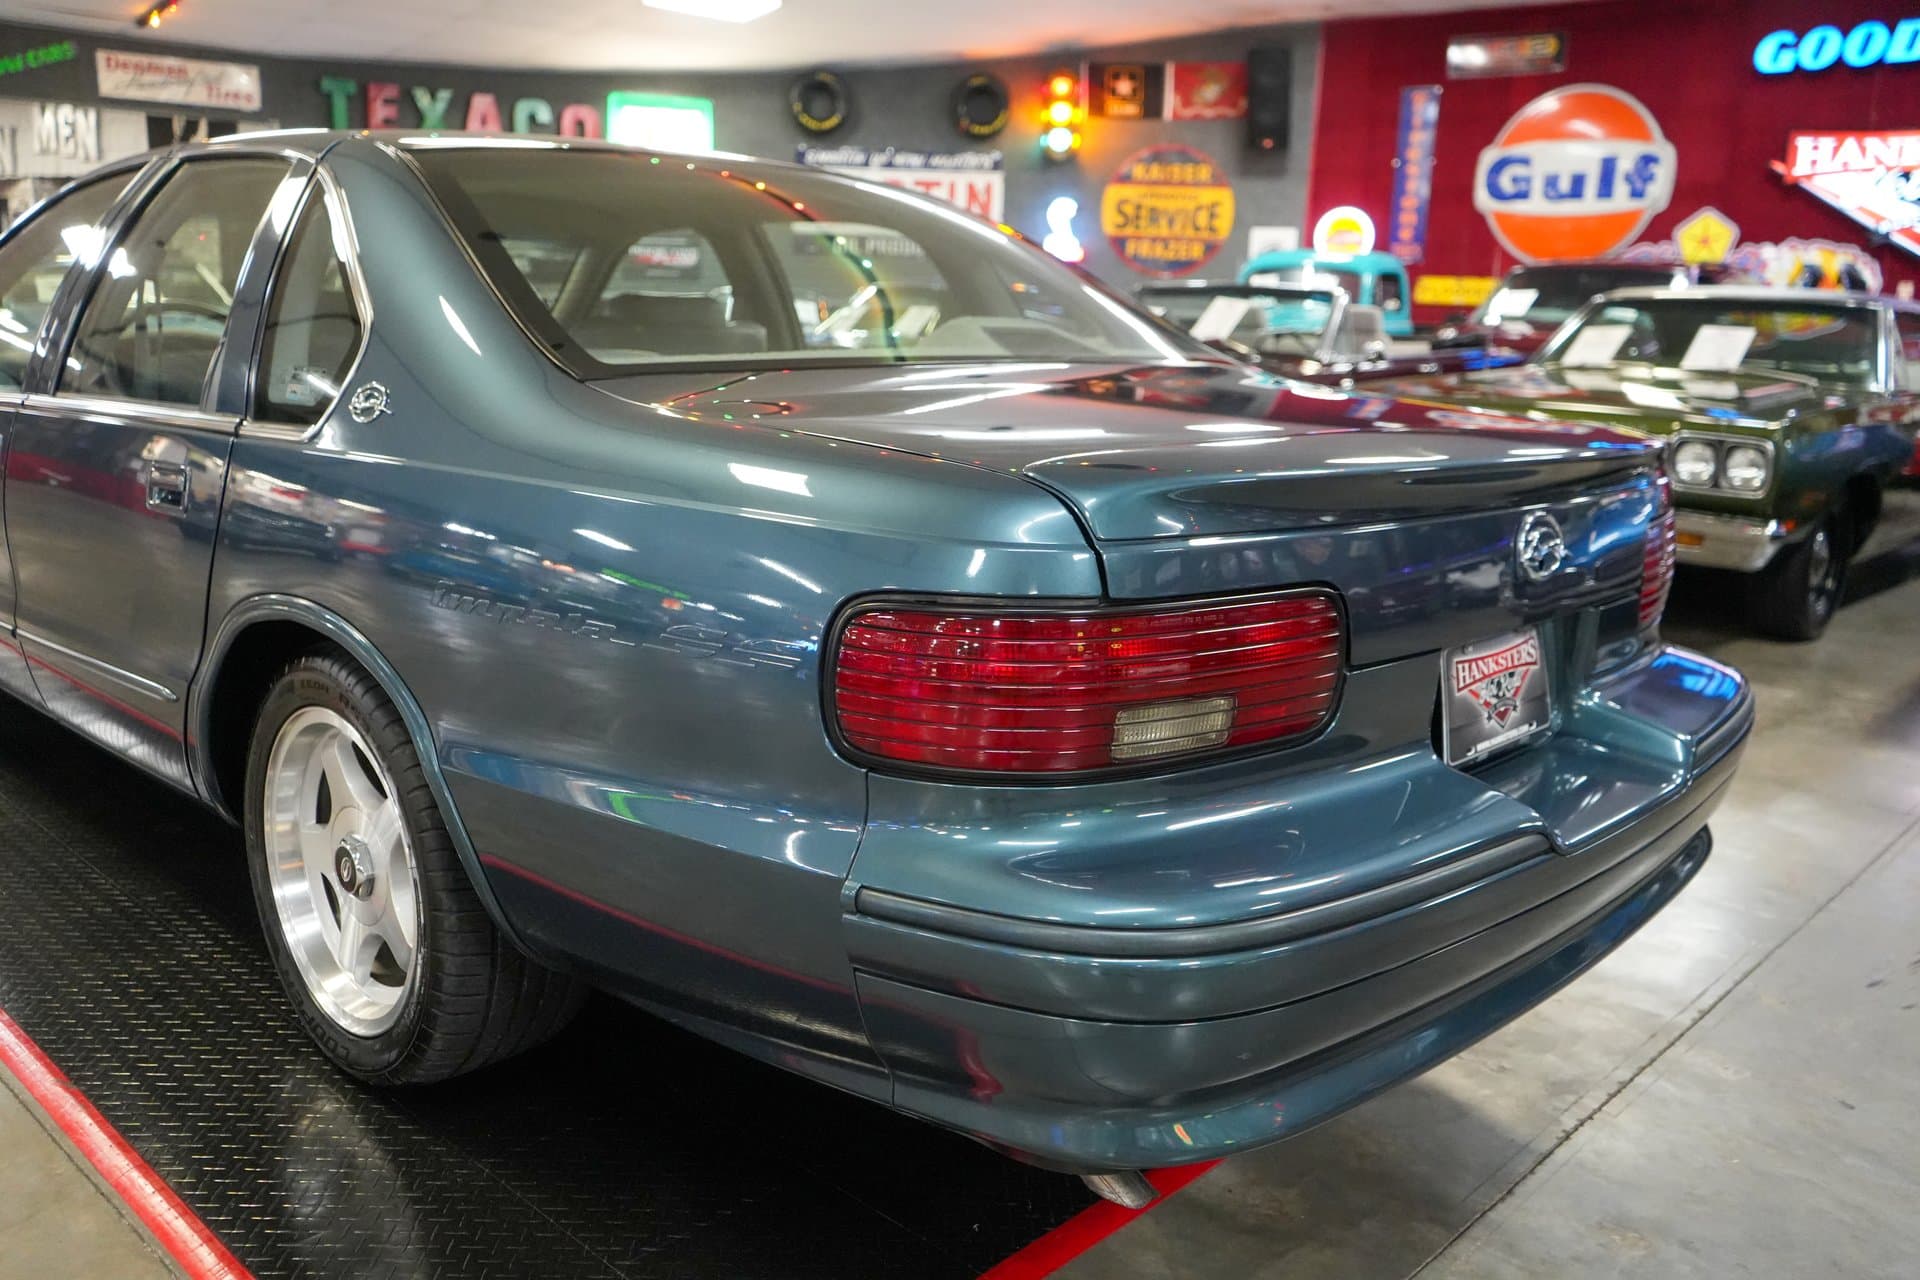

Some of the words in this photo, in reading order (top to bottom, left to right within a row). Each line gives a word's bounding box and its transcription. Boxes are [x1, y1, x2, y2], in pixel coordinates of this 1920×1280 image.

[320, 75, 600, 138] TEXACO
[1487, 154, 1661, 201] Gulf
[1114, 200, 1223, 233] SERVICE
